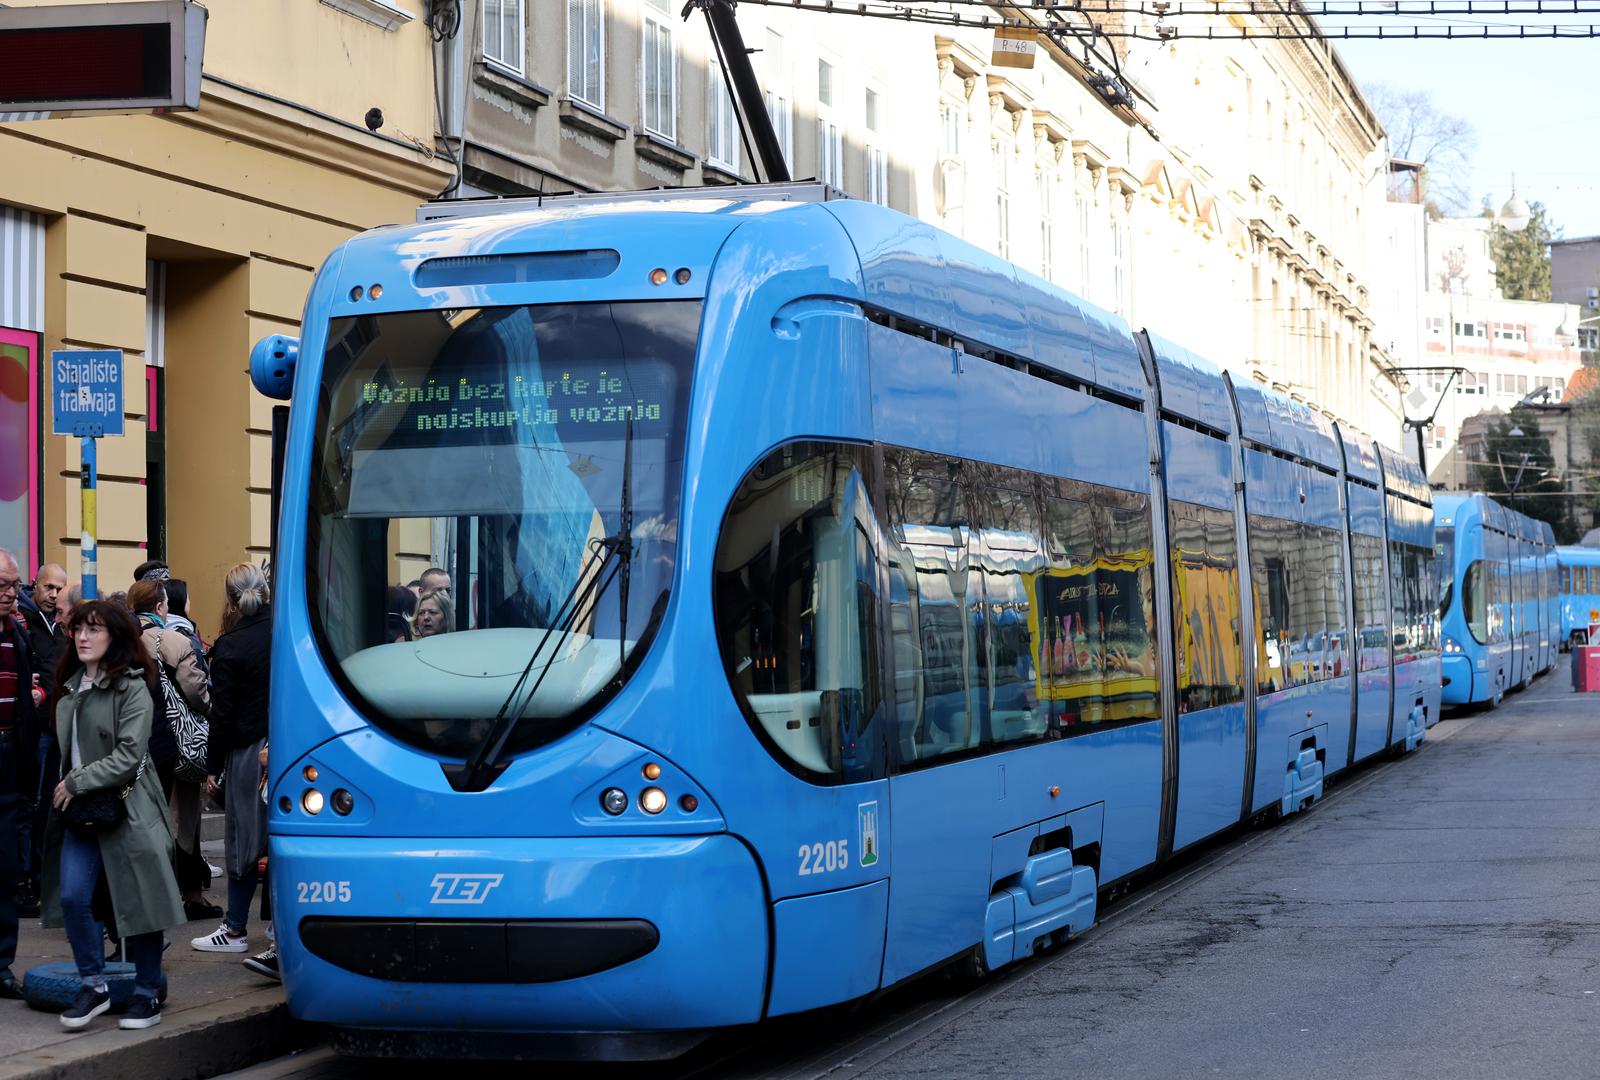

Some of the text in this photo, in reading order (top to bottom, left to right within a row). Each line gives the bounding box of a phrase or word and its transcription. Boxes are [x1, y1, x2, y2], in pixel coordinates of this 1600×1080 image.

[57, 358, 118, 386] Stajalište
[459, 378, 505, 400] bez
[514, 372, 590, 398] karte
[597, 371, 622, 394] je
[417, 398, 660, 430] najskuplja vožnja
[798, 839, 849, 876] 2205
[297, 881, 352, 903] 2205
[430, 873, 504, 904] ZET
